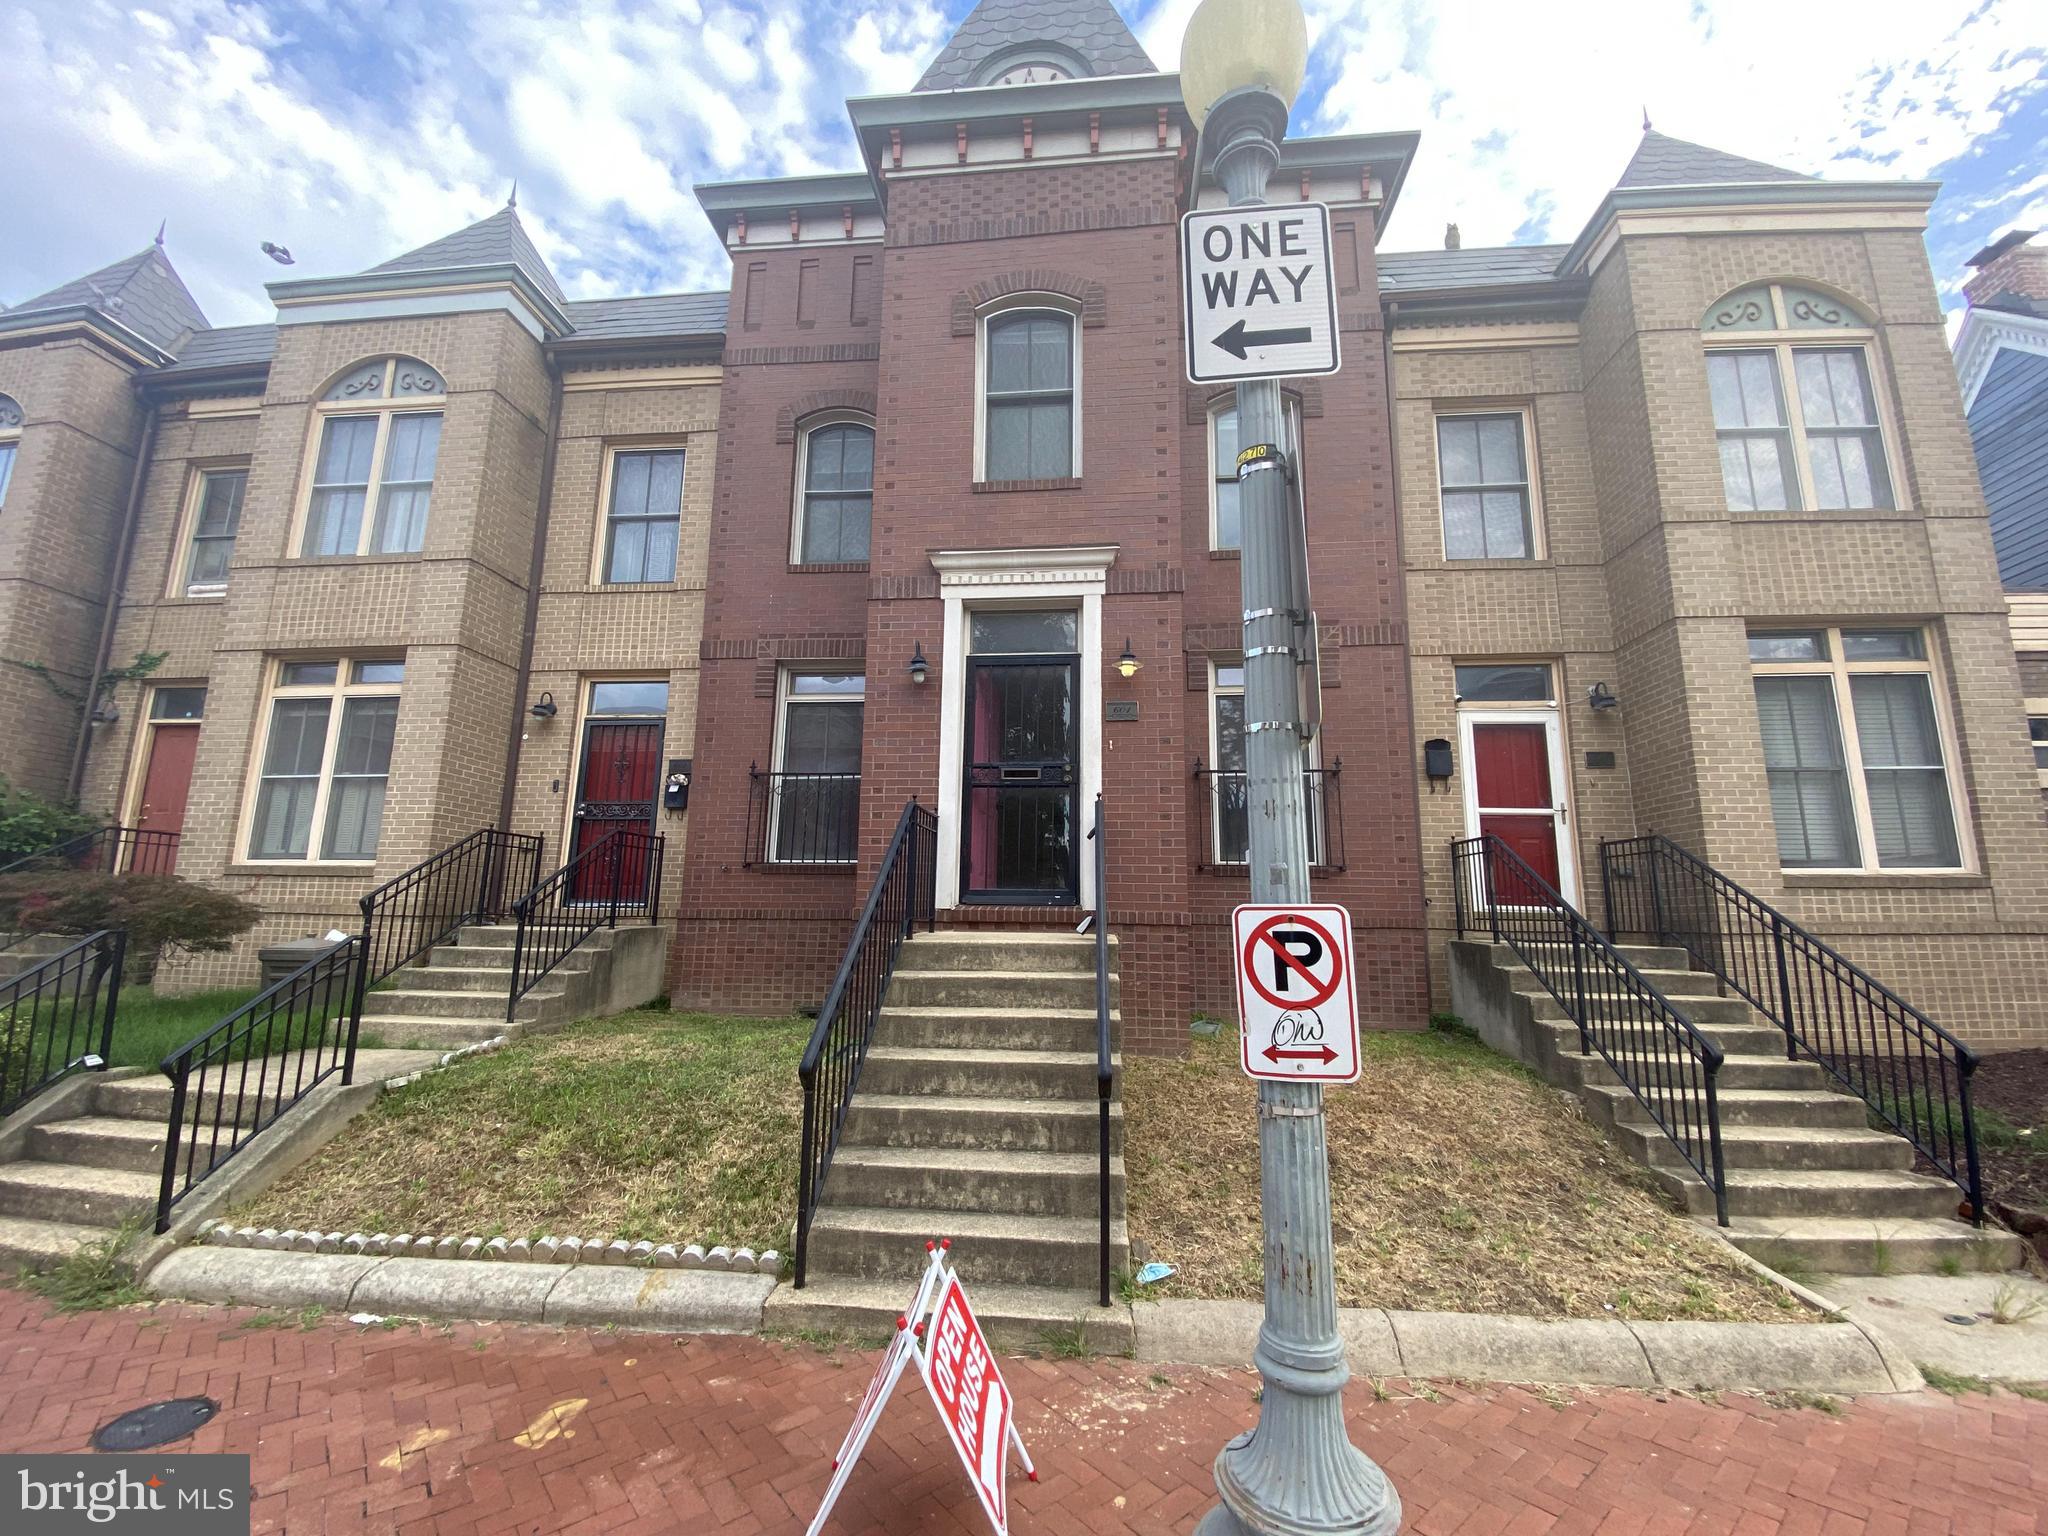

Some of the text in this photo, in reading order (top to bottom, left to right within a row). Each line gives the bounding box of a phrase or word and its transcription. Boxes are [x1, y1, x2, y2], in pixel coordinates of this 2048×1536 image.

[1203, 219, 1307, 262] ONE
[1202, 264, 1314, 309] WAY
[1272, 931, 1322, 991] P
[935, 1296, 967, 1403] OPEN
[957, 1332, 986, 1462] HOUSE
